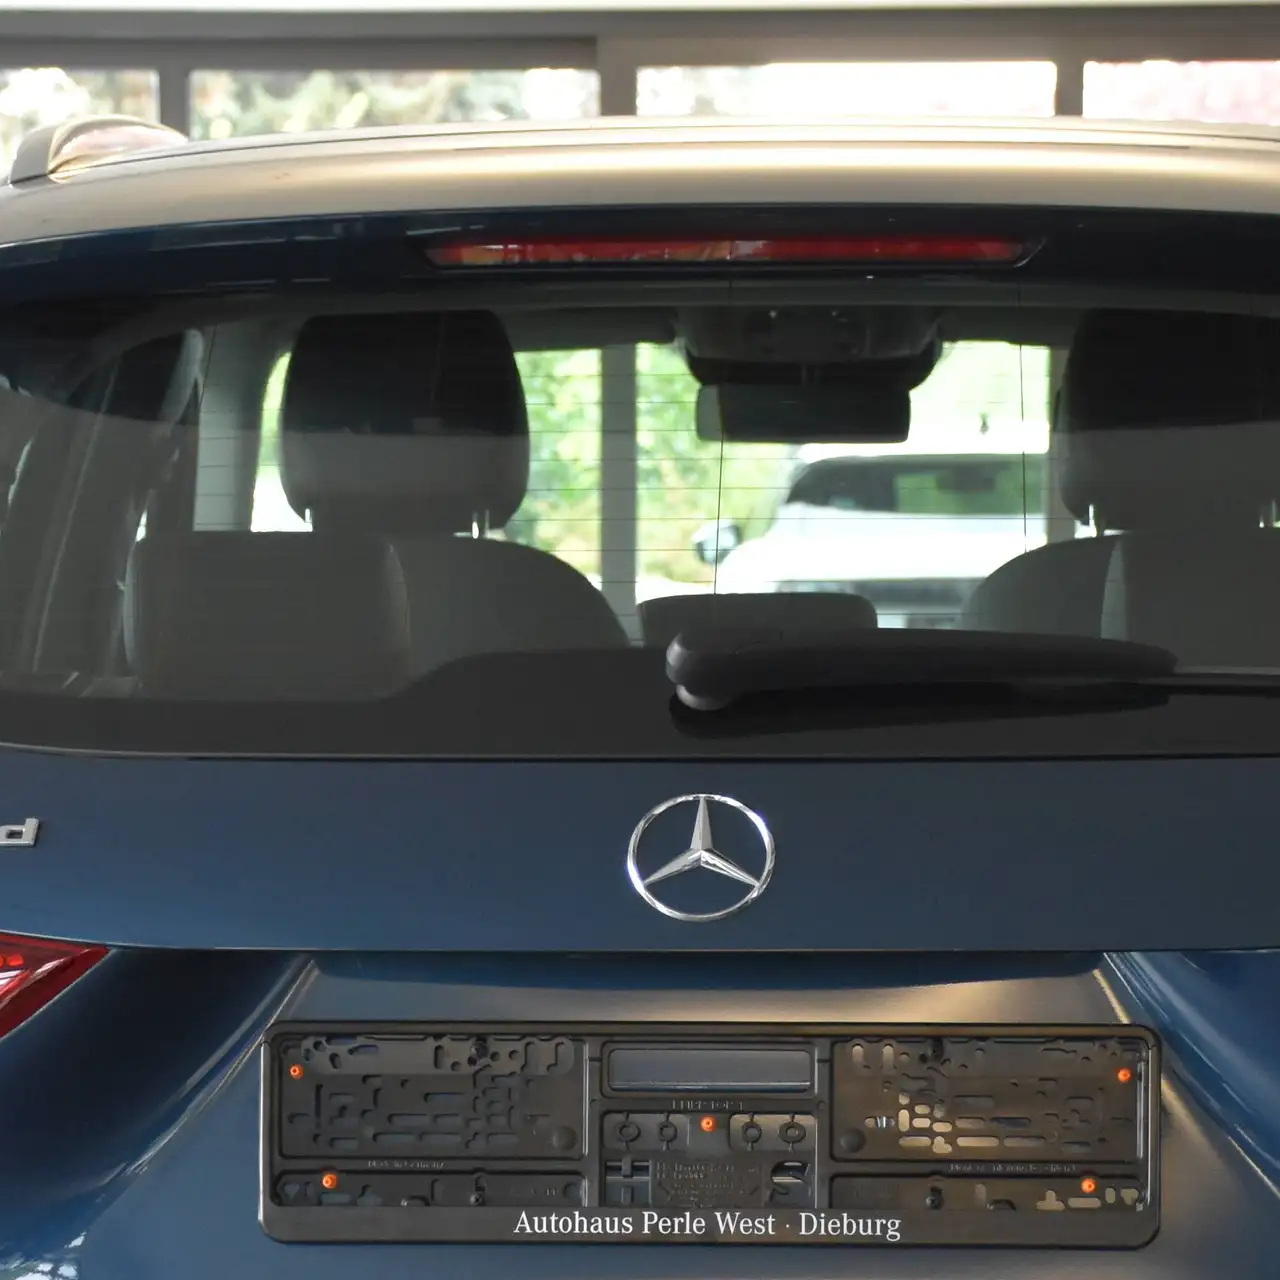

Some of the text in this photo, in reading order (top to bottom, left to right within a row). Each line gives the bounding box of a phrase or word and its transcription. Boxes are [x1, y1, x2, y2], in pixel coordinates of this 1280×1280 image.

[513, 1210, 902, 1242] Autohaus Perle West Dieburg
